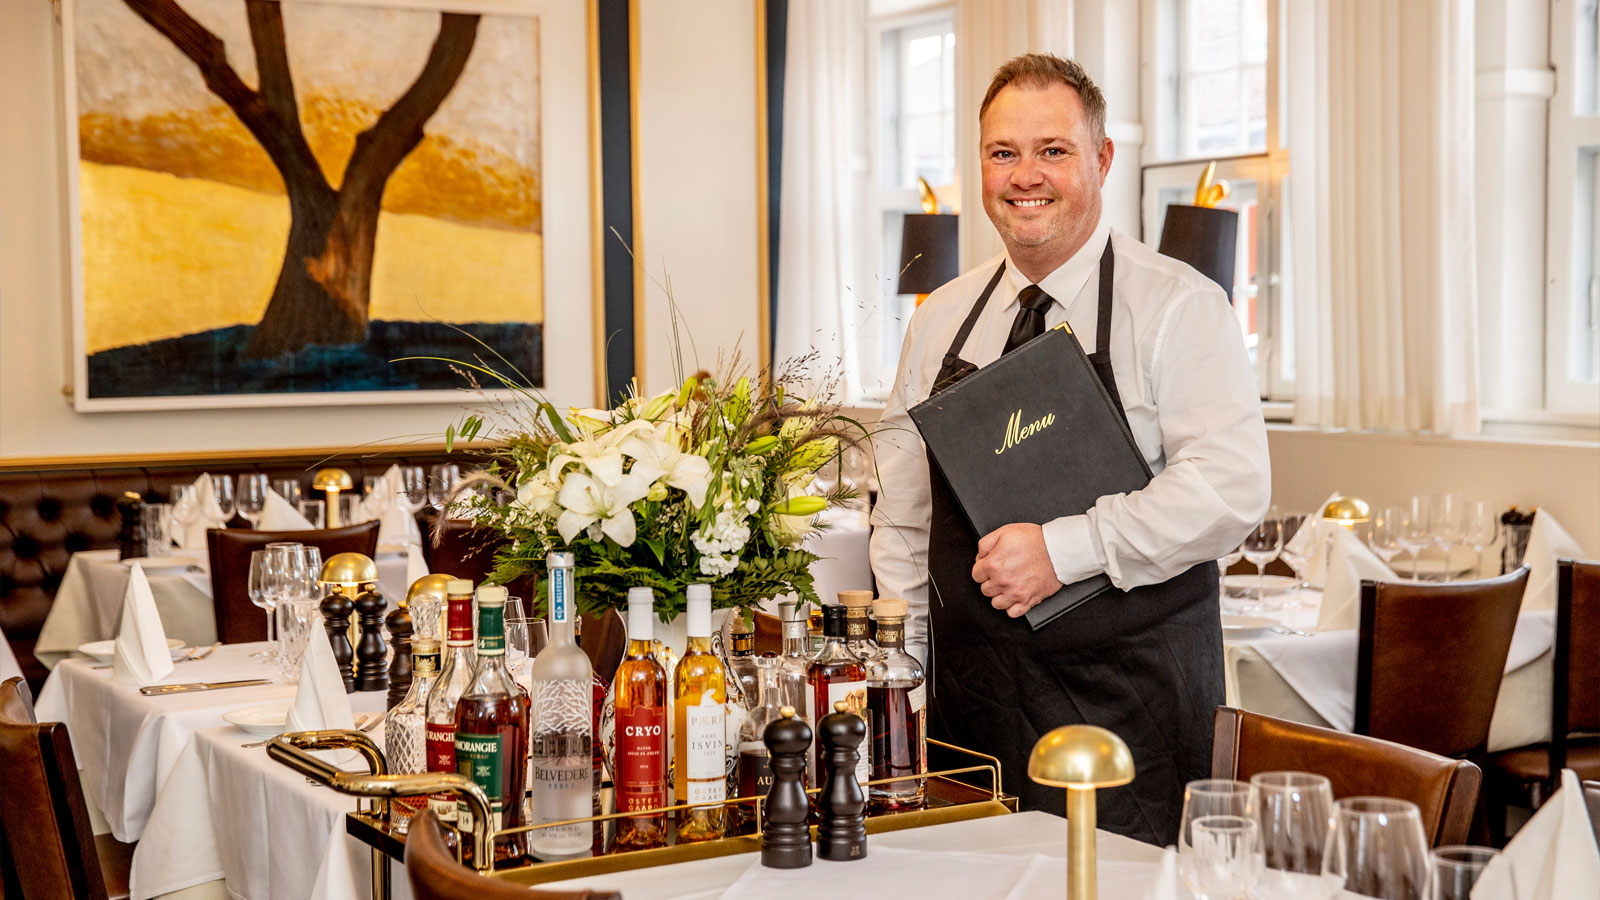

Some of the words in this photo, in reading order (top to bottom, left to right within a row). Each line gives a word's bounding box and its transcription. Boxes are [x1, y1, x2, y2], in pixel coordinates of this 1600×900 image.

[994, 408, 1056, 455] Menu
[625, 725, 661, 737] CRYO
[692, 740, 723, 750] ISVIN
[535, 767, 589, 781] BELVEDERE
